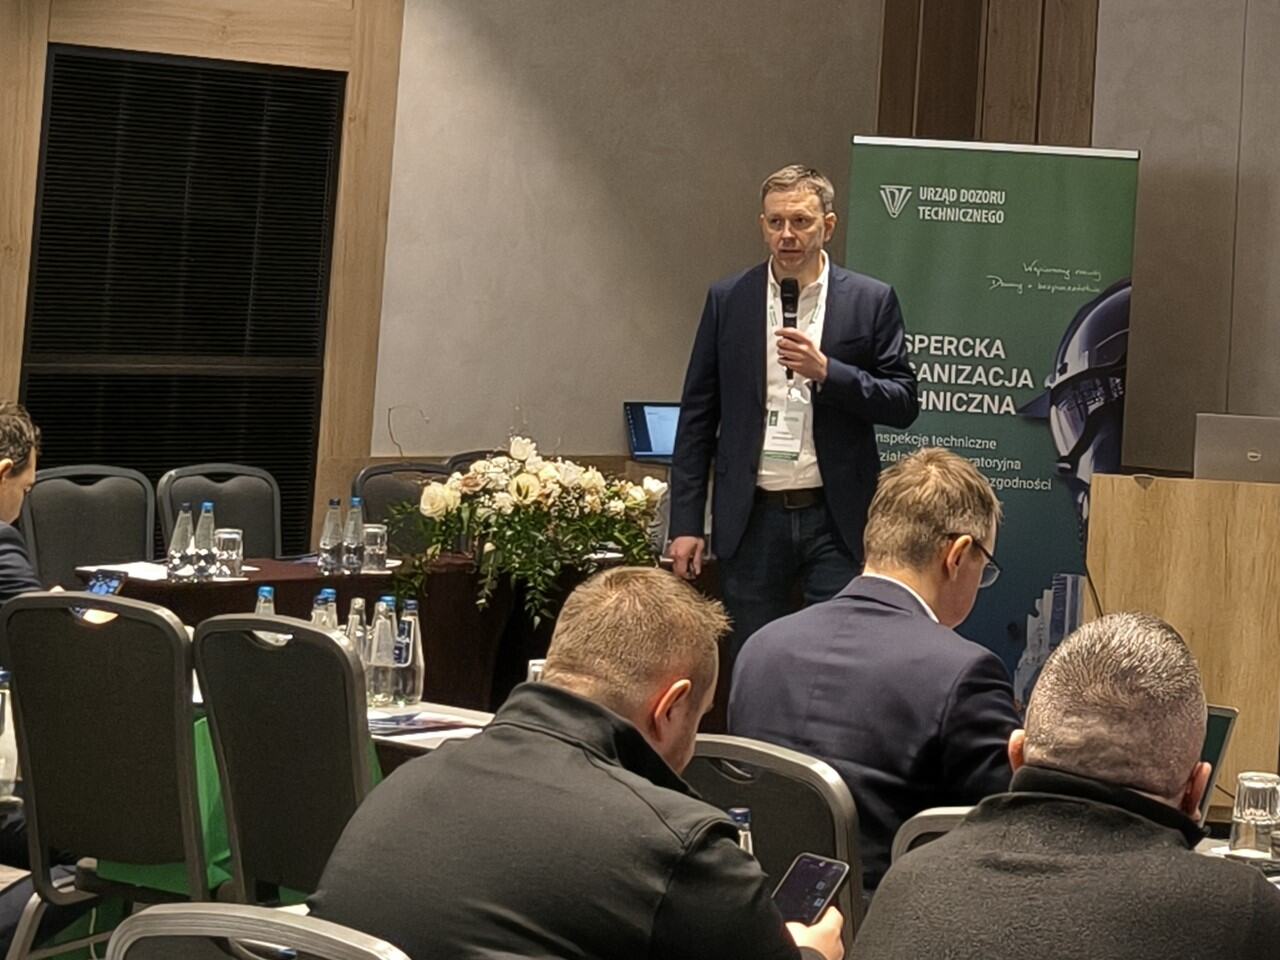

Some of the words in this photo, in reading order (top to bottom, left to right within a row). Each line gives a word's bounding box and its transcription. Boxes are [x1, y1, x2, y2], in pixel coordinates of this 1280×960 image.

[919, 186, 957, 204] URZĄD
[960, 188, 1006, 205] DOZORU
[918, 206, 1005, 224] TECHNICZNEGO
[904, 334, 1006, 360] SPERCKA
[875, 431, 929, 447] nspekcje
[932, 434, 997, 450] techniczne
